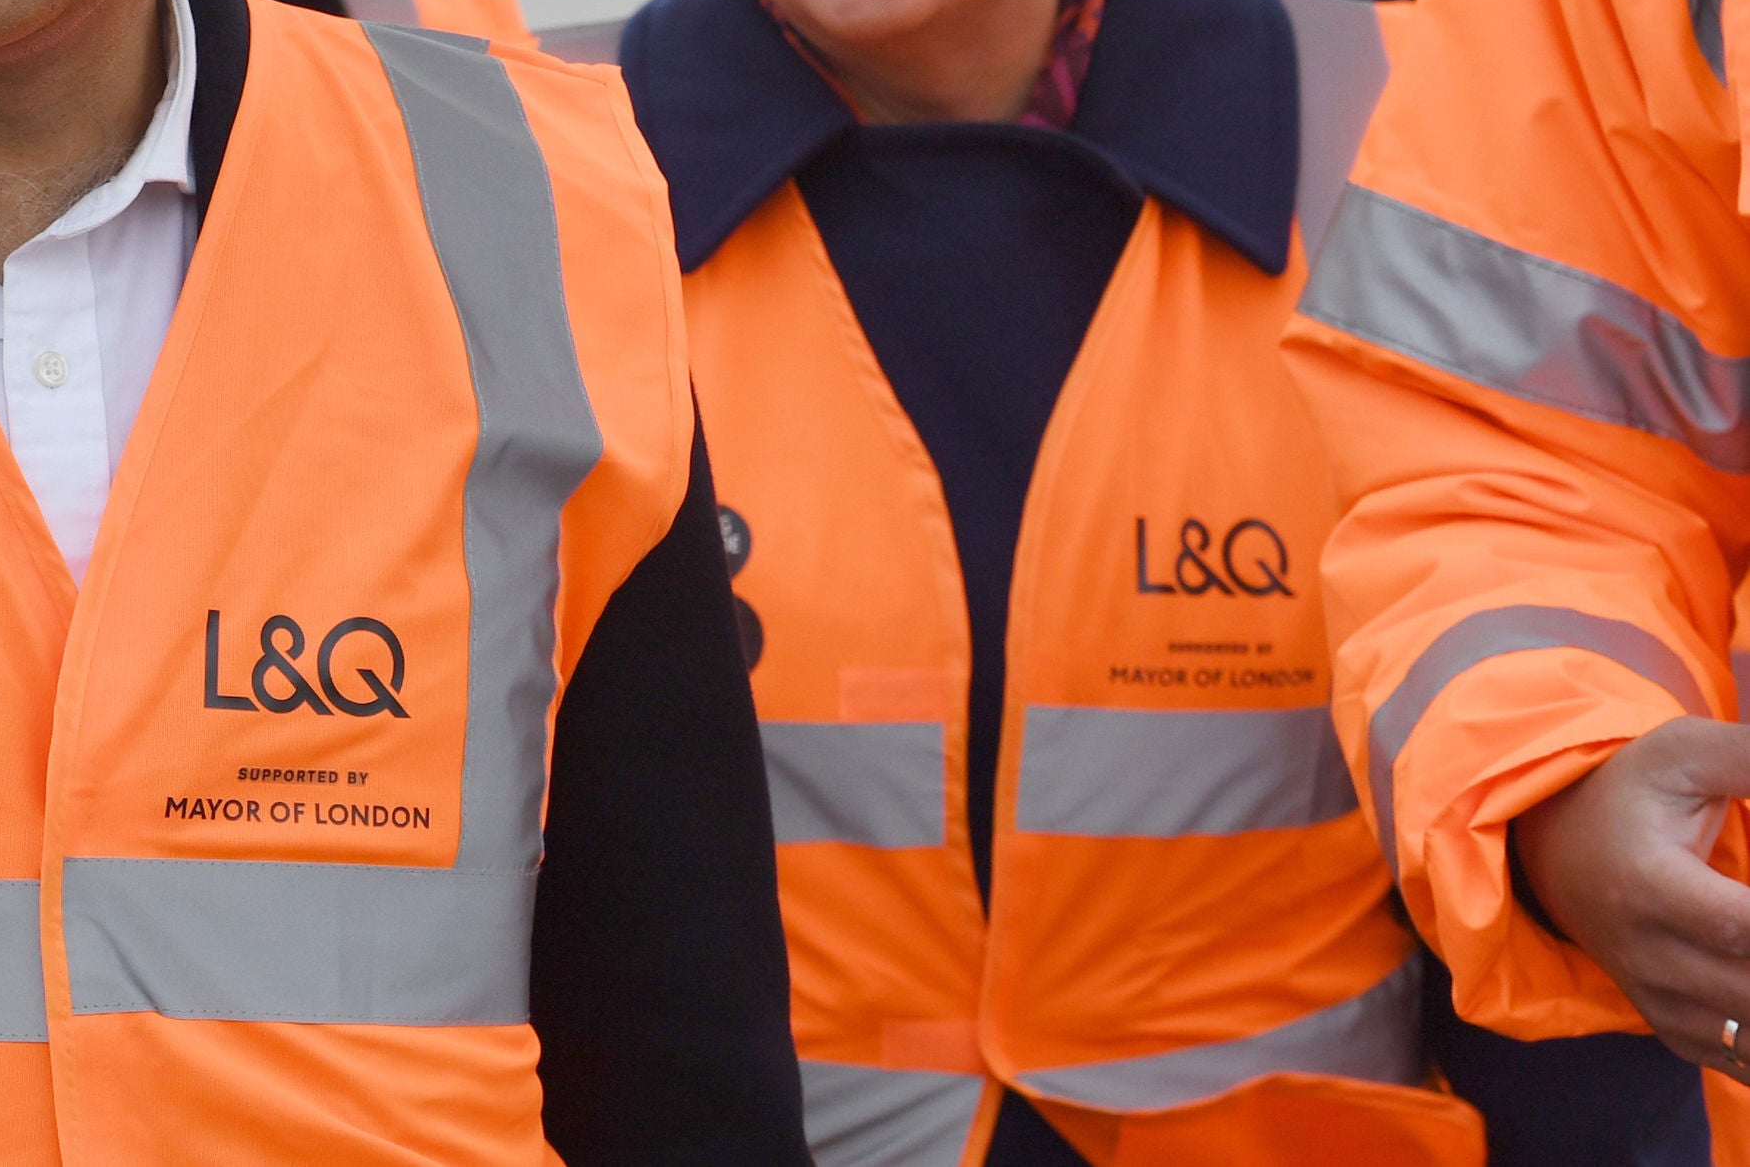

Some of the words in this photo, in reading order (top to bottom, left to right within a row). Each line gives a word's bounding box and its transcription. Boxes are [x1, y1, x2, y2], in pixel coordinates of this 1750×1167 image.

[1137, 517, 1294, 597] L&Q
[204, 609, 411, 719] L&Q
[1110, 667, 1188, 685] MAYOR
[1196, 669, 1223, 685] OF
[238, 768, 338, 784] SUPPORTED
[348, 772, 369, 785] BY
[165, 797, 261, 822] MAYOR
[270, 802, 305, 824] OF
[315, 803, 431, 829] LONDON
